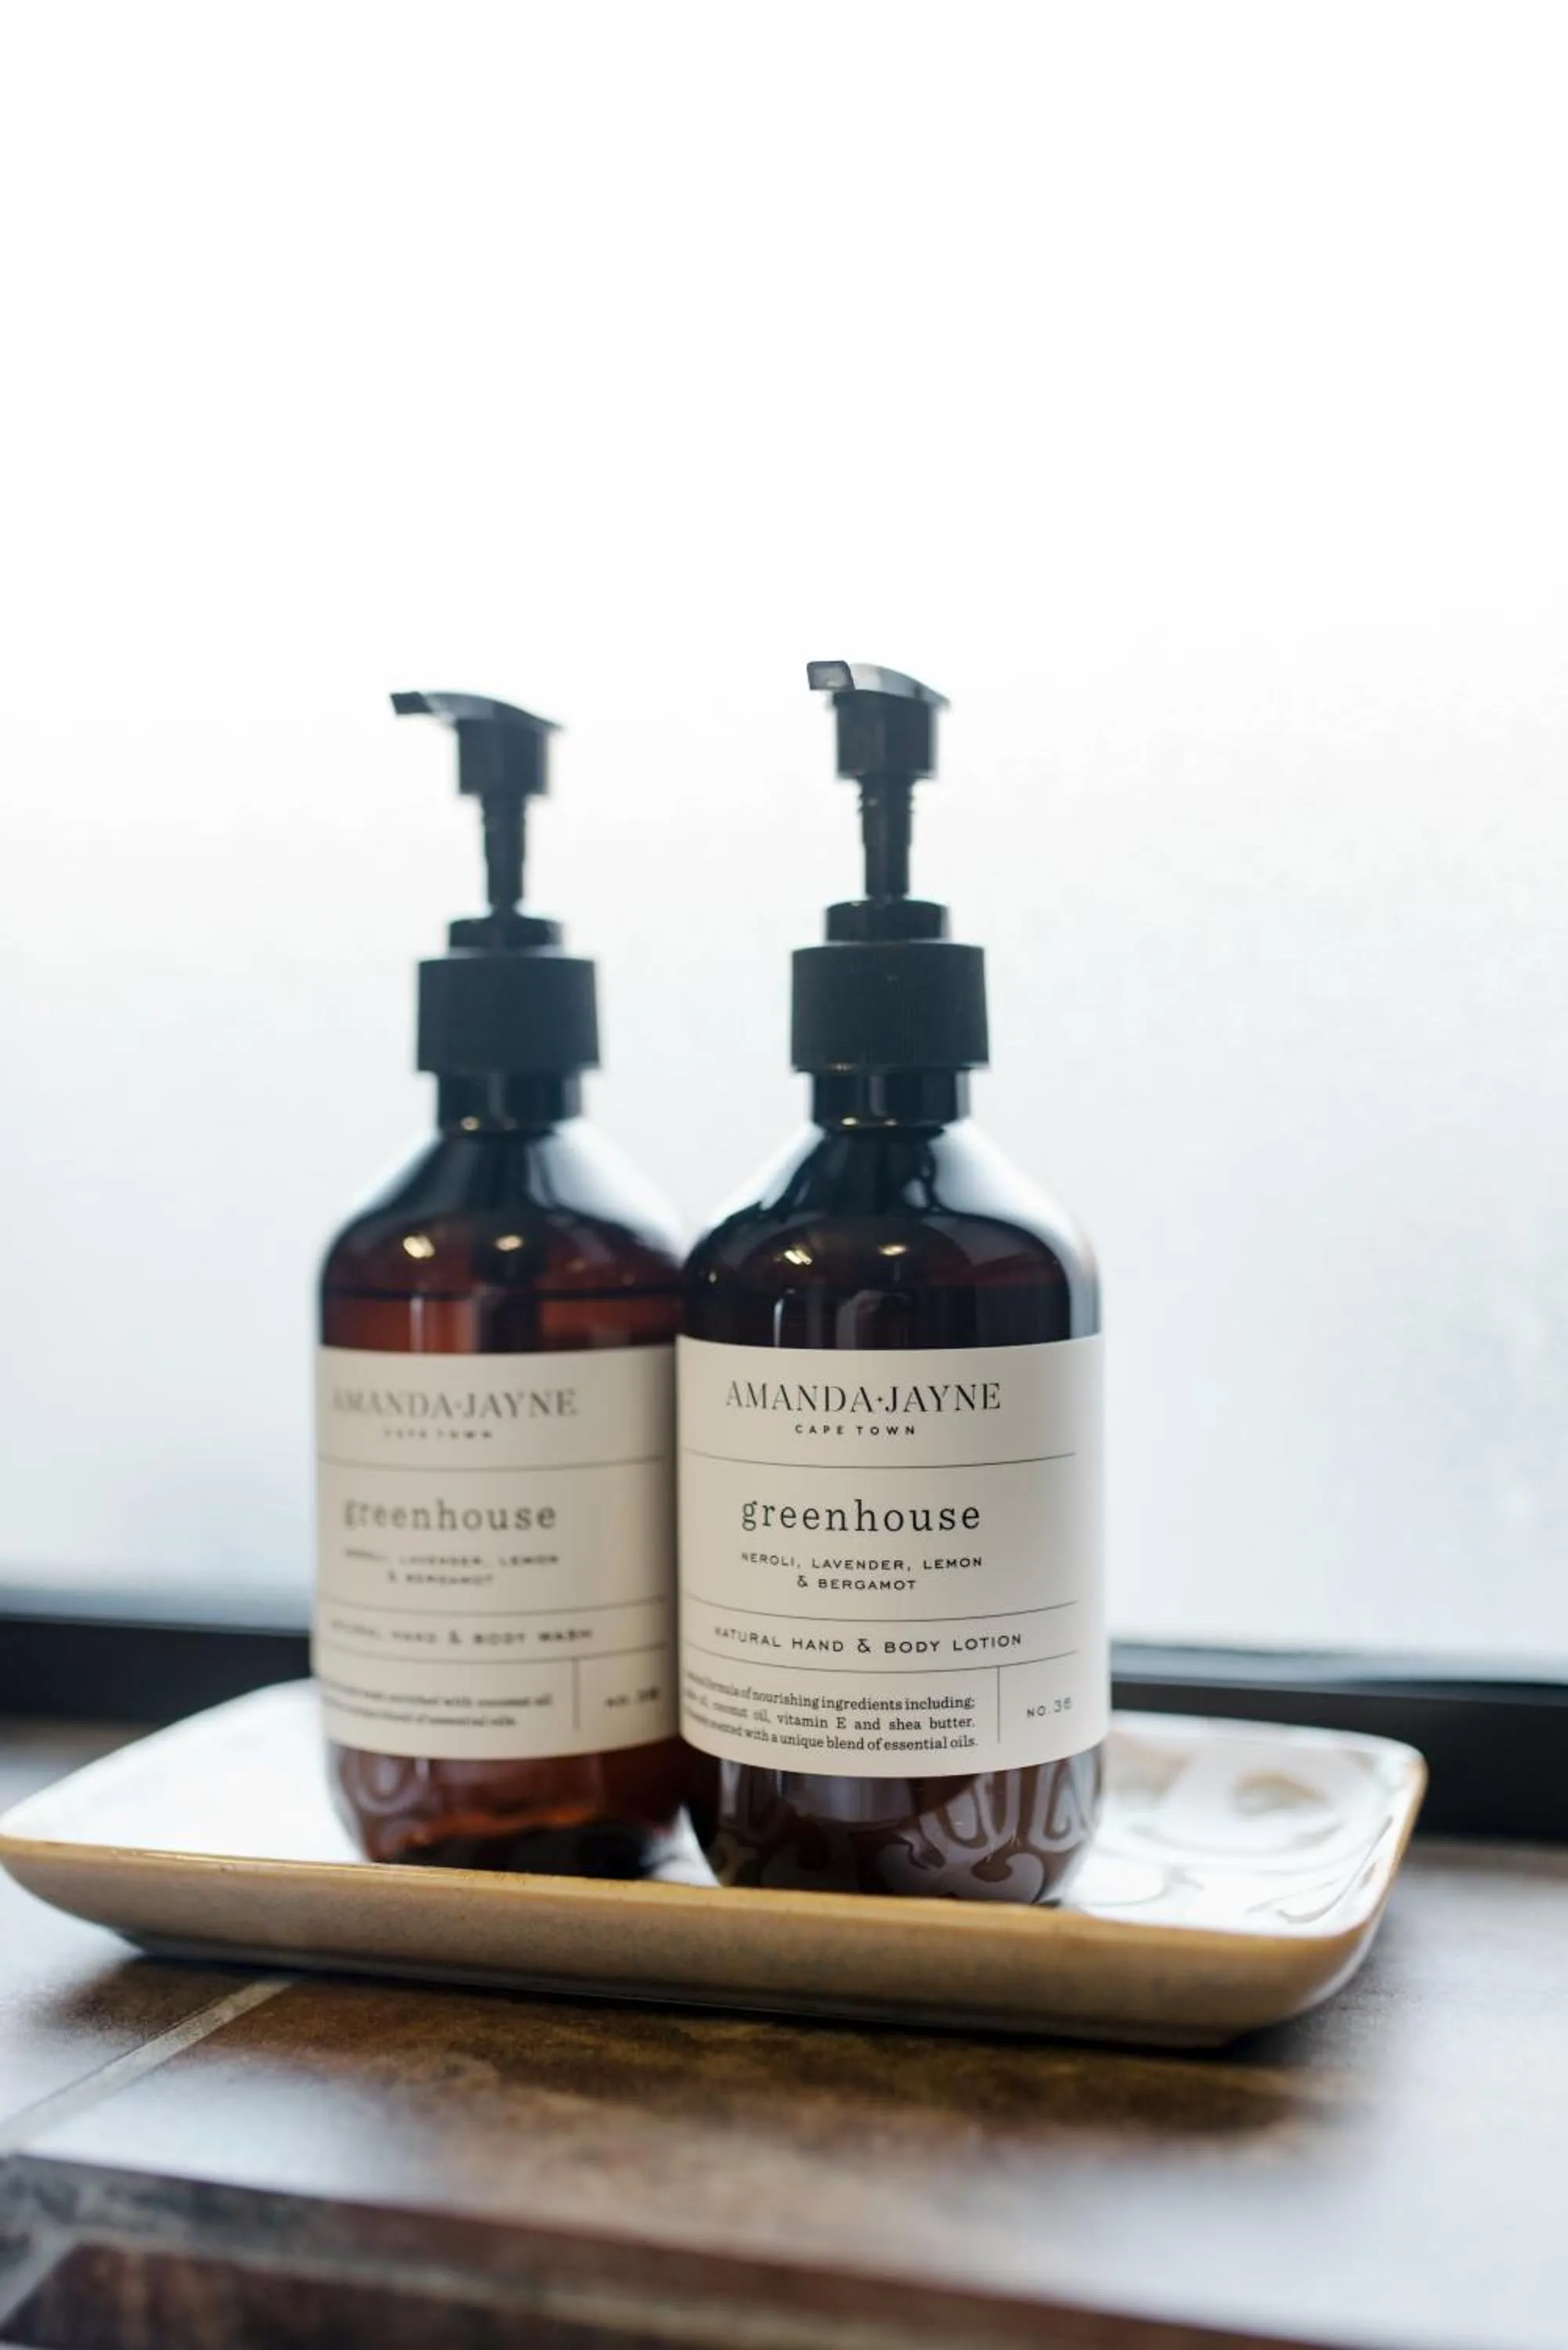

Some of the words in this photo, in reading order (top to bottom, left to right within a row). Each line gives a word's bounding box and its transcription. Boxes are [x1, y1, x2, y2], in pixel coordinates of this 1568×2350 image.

[794, 1424, 844, 1436] CAPE
[856, 1426, 916, 1436] TOWN
[345, 1497, 557, 1531] greenhouse
[741, 1499, 981, 1532] greenhouse
[741, 1552, 800, 1568] NEROLI,
[811, 1558, 912, 1571] LAVENDER,
[923, 1556, 983, 1570] LEMON
[797, 1574, 809, 1589] &
[818, 1578, 917, 1591] BERGAMOT
[714, 1625, 782, 1648] NATURAL
[792, 1637, 844, 1653] HAND
[856, 1637, 872, 1654] &
[883, 1640, 941, 1654] BODY
[952, 1633, 1022, 1652] LOTION
[752, 1691, 821, 1710] nourishing
[821, 1695, 902, 1712] ingredients
[777, 1712, 829, 1729] vitamin
[836, 1716, 847, 1730] E
[854, 1717, 881, 1730] and
[889, 1716, 922, 1730] shea
[929, 1716, 976, 1730] butter.
[779, 1734, 827, 1750] unique
[826, 1734, 865, 1750] blend
[867, 1737, 883, 1751] of
[884, 1736, 948, 1752] essential
[949, 1734, 979, 1748] oils.
